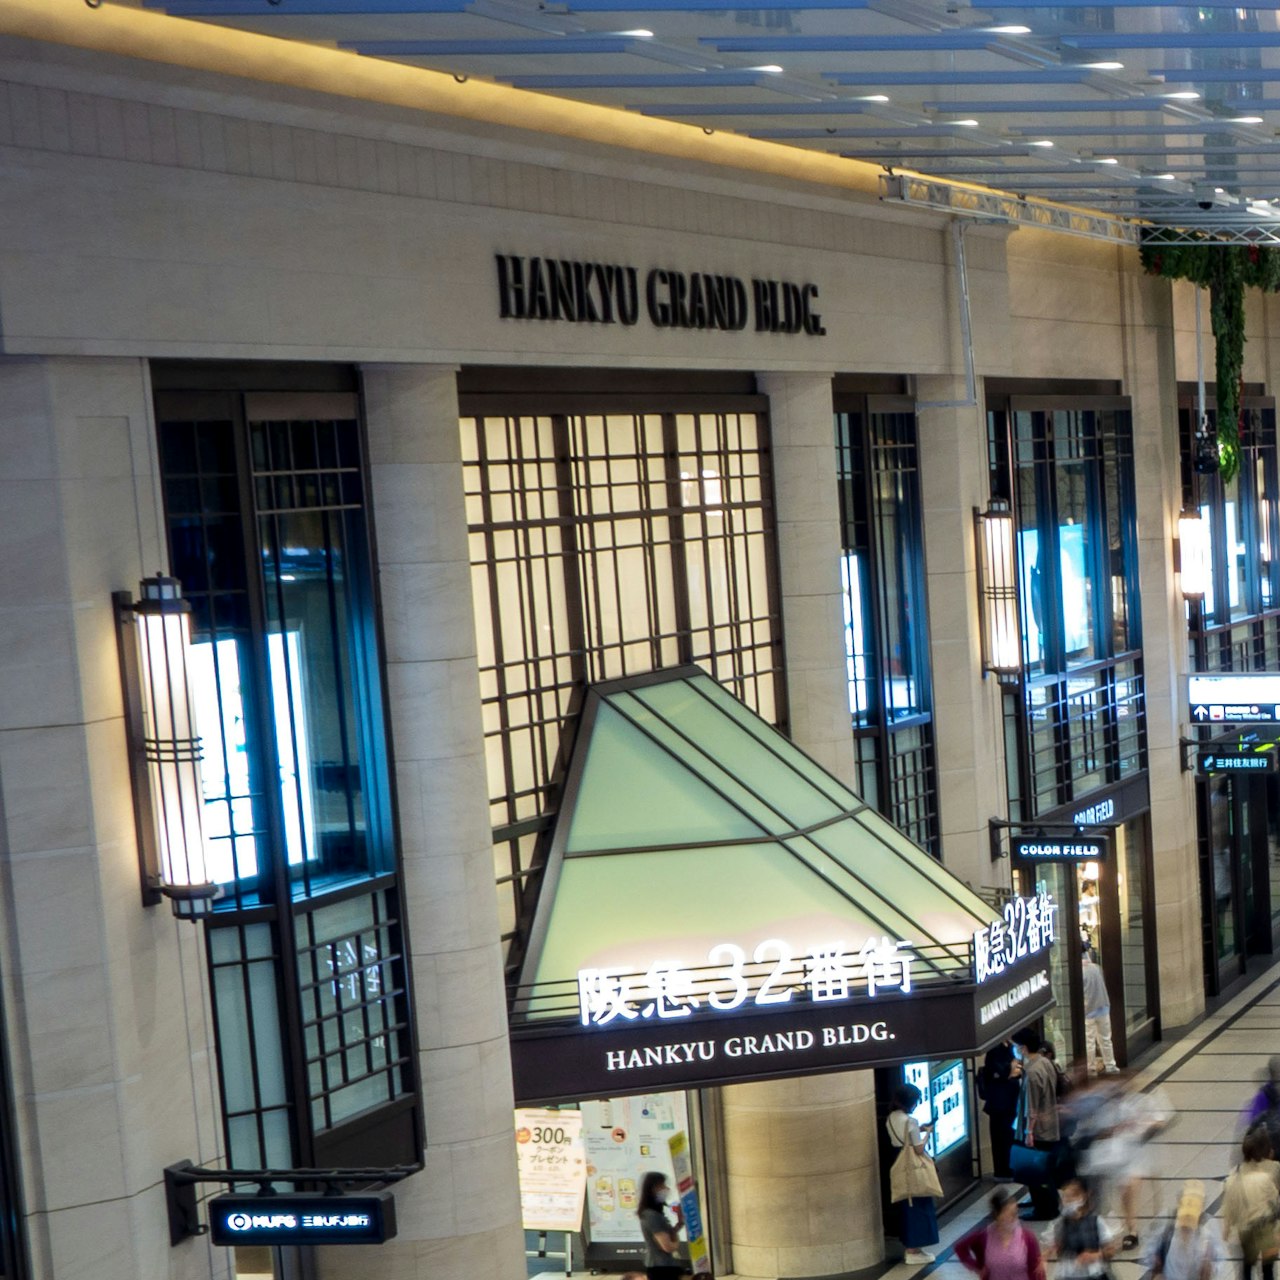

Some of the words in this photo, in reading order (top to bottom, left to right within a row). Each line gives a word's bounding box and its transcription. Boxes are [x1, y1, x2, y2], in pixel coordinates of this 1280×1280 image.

[495, 254, 639, 325] HANKYU
[646, 268, 748, 331] GRAND
[752, 278, 827, 336] BLDG.
[1216, 758, 1268, 768] 三井住友銀行
[1020, 845, 1061, 855] COLOR
[577, 936, 916, 1026] 阪急32番街
[606, 1041, 715, 1071] HANKYU
[724, 1030, 813, 1057] GRAND
[822, 1021, 896, 1046] BLDG.
[532, 1127, 572, 1145] 300円
